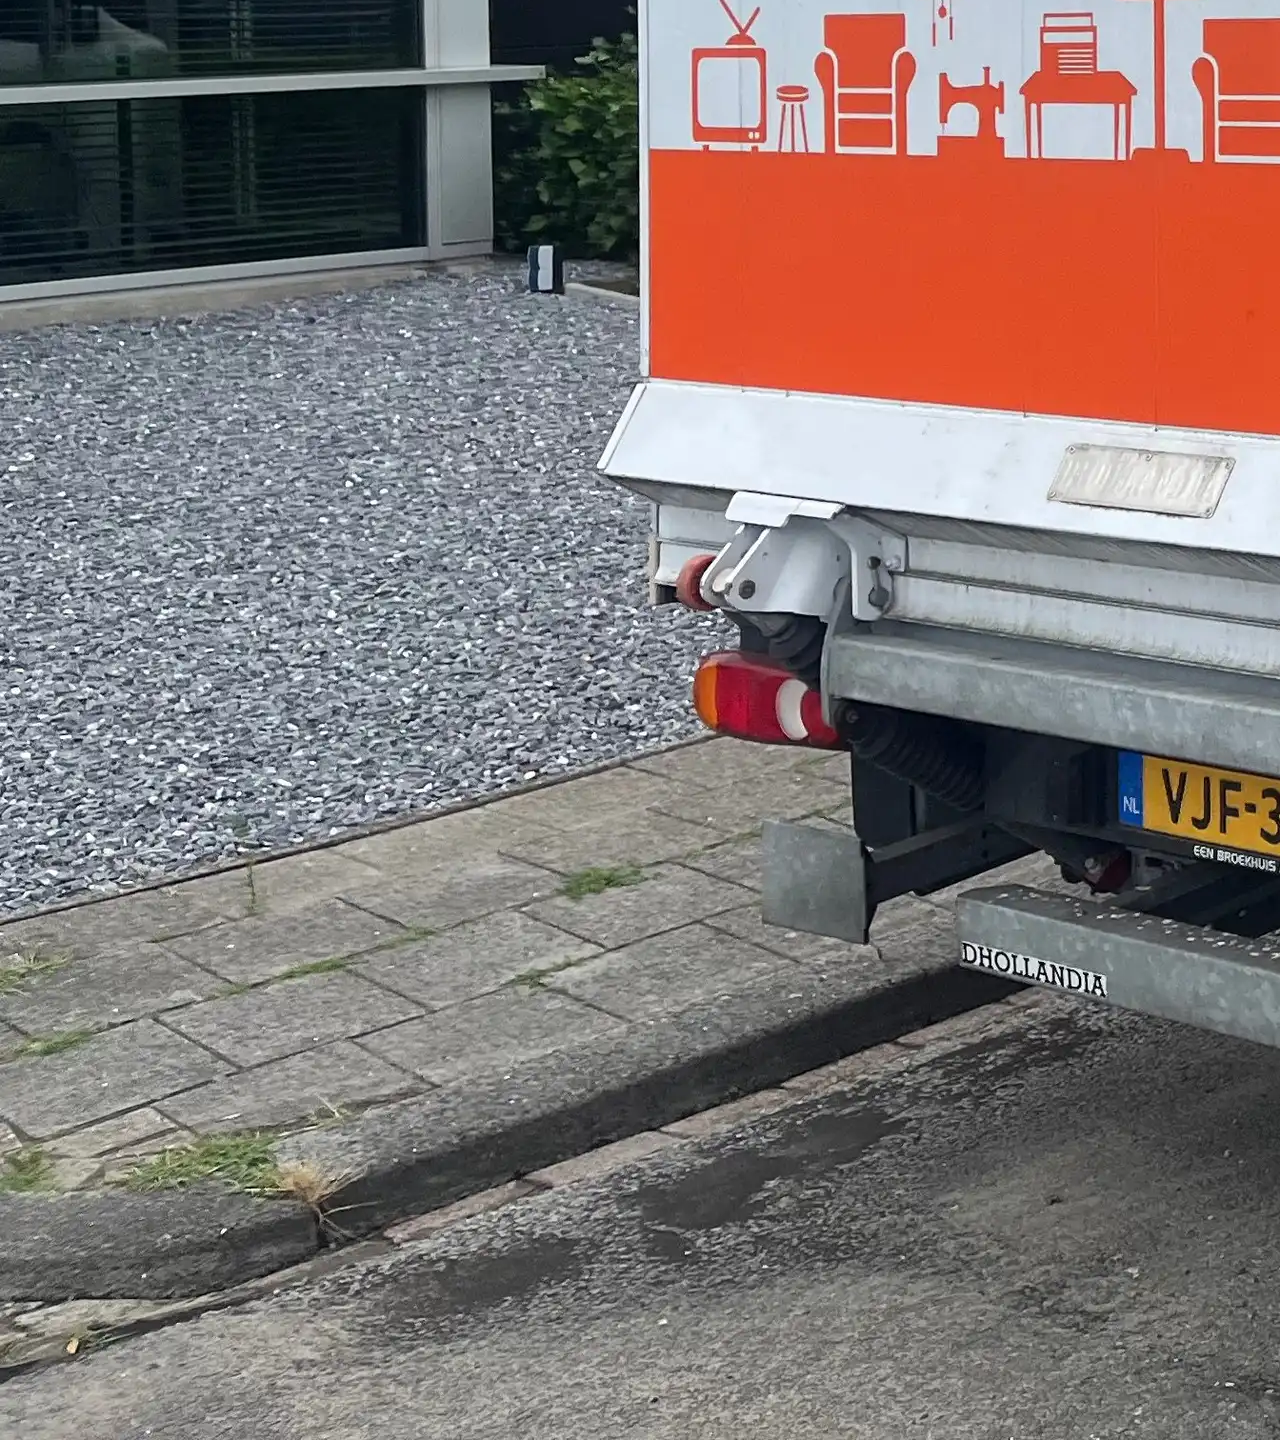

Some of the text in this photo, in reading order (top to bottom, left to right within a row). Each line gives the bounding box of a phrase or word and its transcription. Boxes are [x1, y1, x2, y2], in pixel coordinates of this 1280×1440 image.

[1123, 796, 1140, 815] NL
[1217, 850, 1277, 872] BROEKHUIS
[961, 941, 1107, 998] DHOLLANDIA
